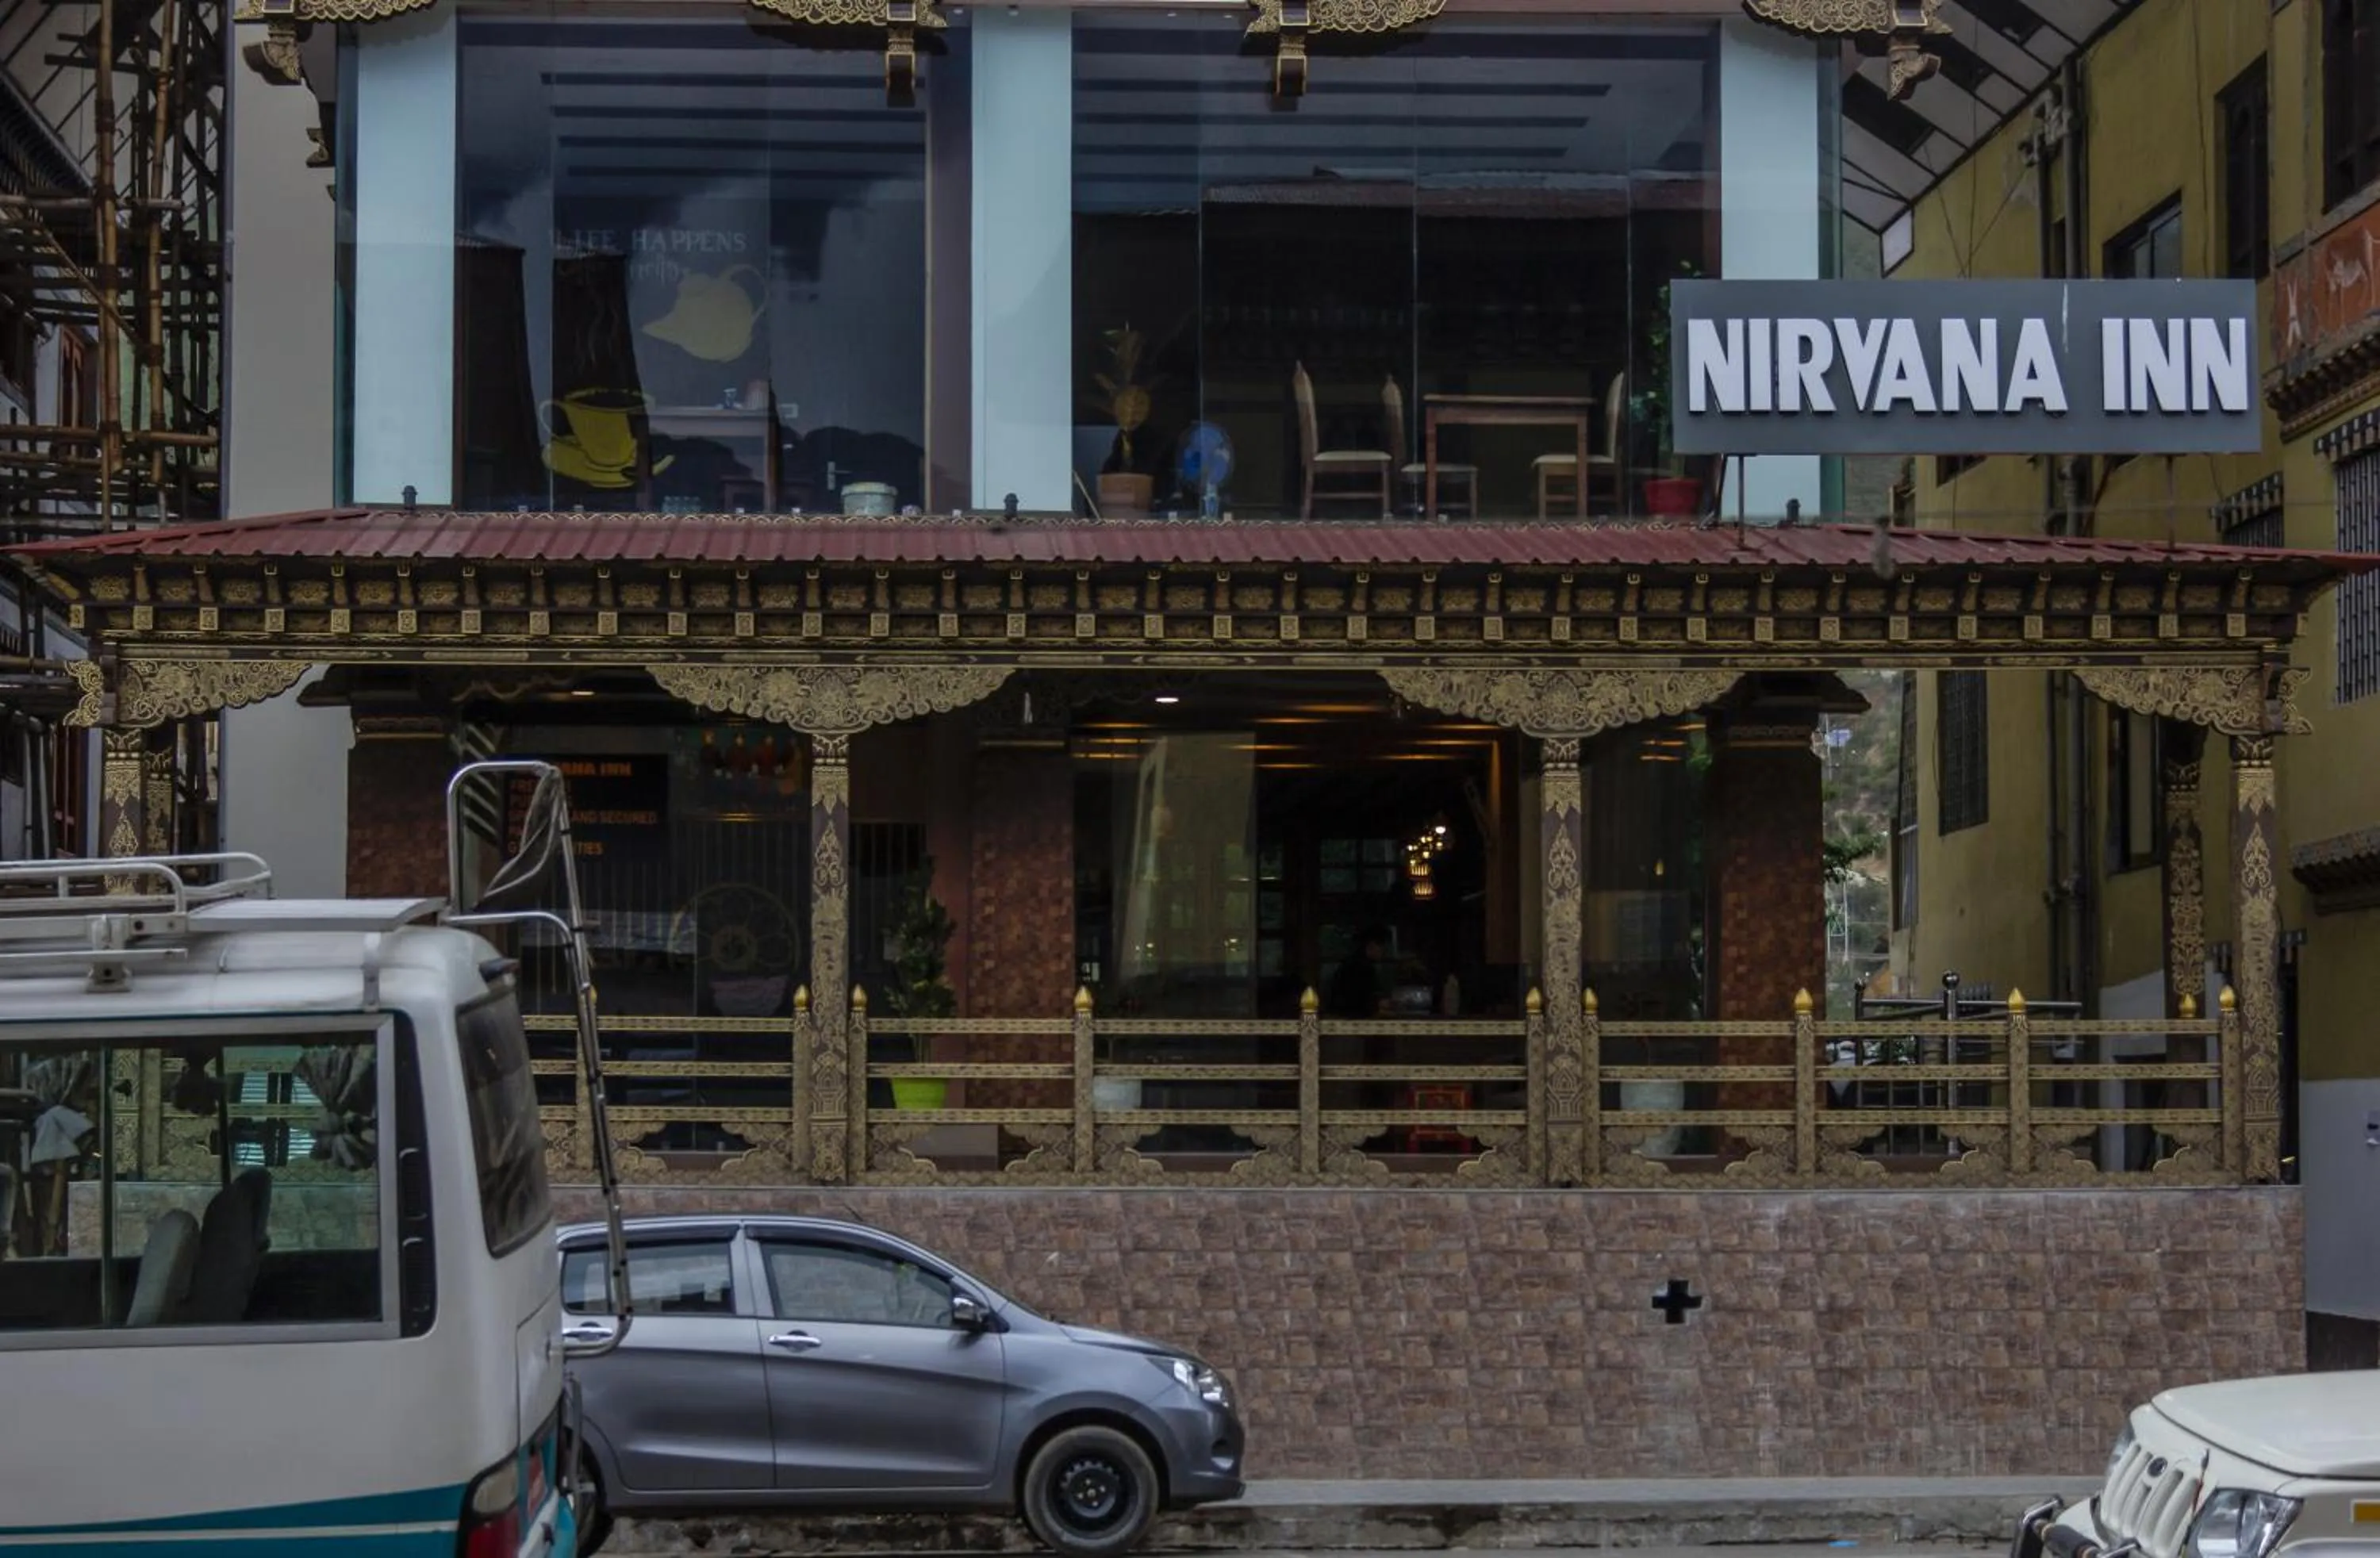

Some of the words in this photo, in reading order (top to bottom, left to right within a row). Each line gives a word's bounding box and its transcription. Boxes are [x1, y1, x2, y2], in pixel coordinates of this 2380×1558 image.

[631, 228, 747, 252] HAPPENS
[1687, 317, 2068, 413] NIRVANA
[2101, 317, 2248, 413] INN
